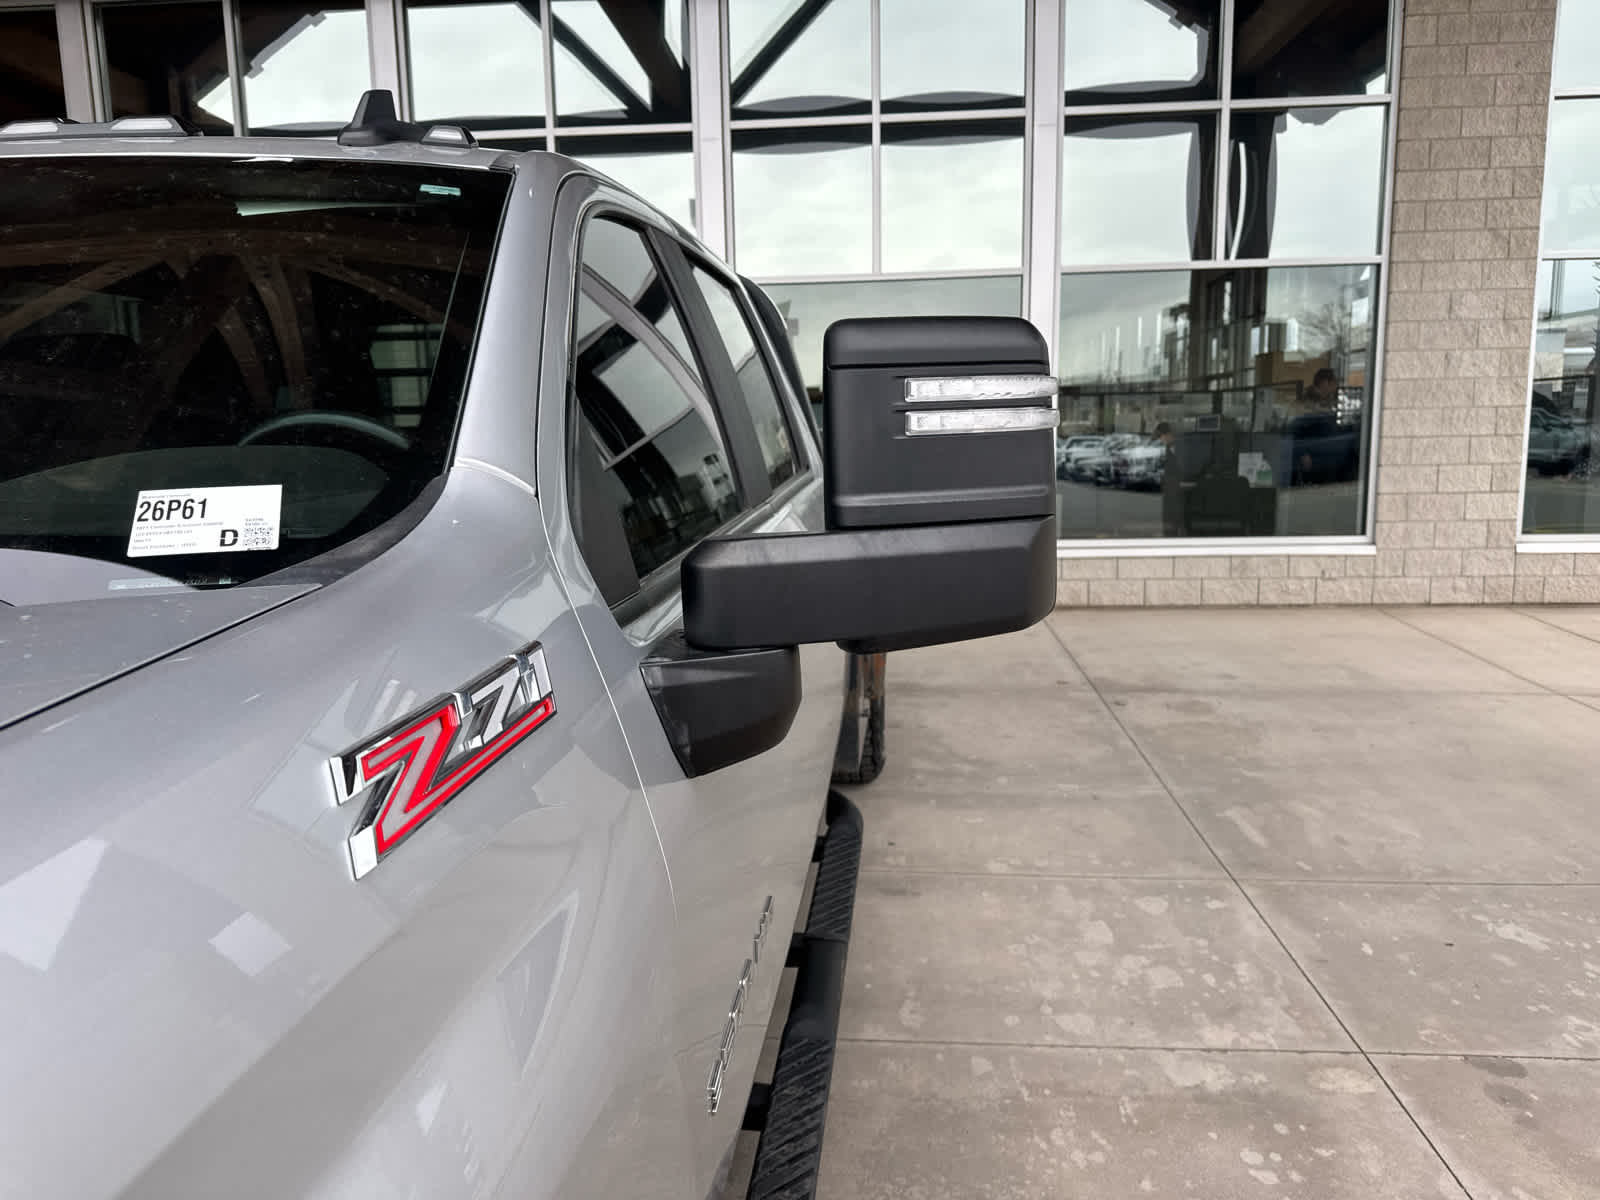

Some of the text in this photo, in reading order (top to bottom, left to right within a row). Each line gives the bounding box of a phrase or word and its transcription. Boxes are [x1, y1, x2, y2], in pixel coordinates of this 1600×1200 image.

[137, 498, 207, 522] 26P61
[219, 529, 239, 547] D
[326, 640, 557, 881] Z71
